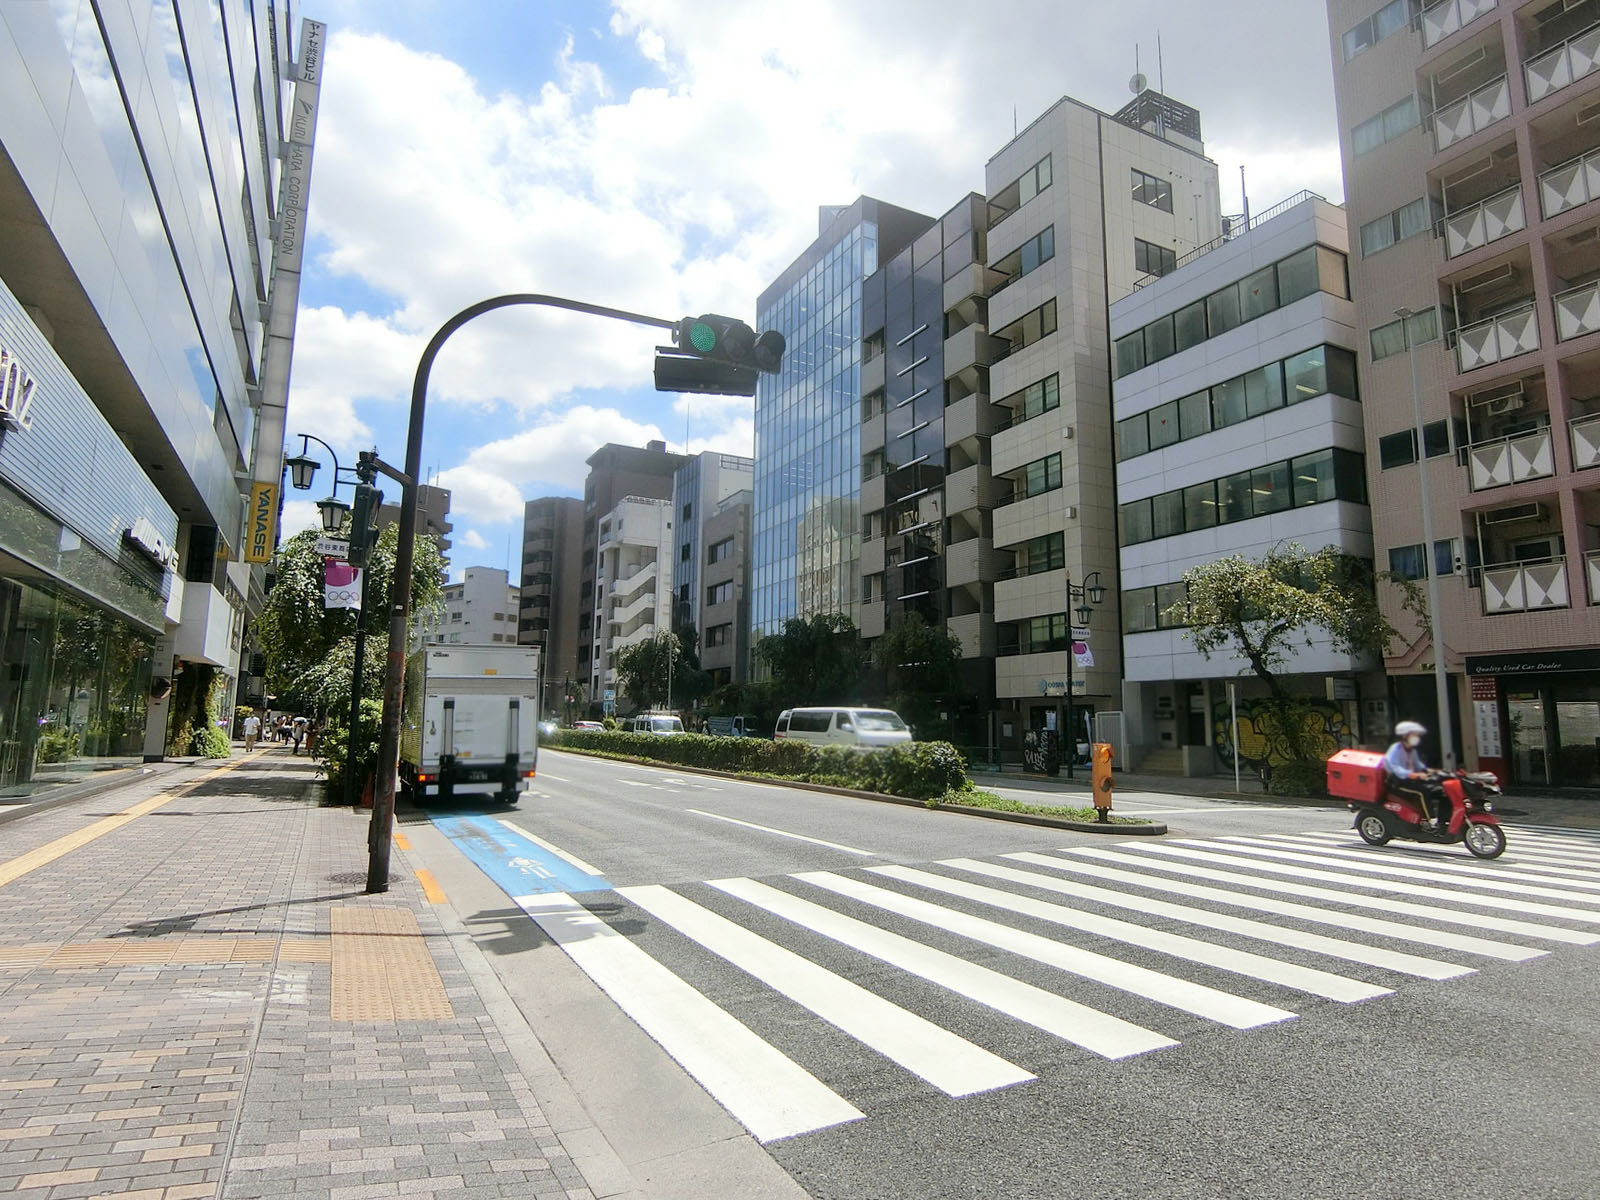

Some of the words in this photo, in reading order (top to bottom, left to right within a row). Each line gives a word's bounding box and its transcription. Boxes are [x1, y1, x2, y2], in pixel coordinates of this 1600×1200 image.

[303, 22, 320, 80] ヤナセ渋谷ビル
[282, 177, 301, 256] CORPORATION
[253, 488, 271, 557] YANASE
[1536, 662, 1562, 670] Dealer
